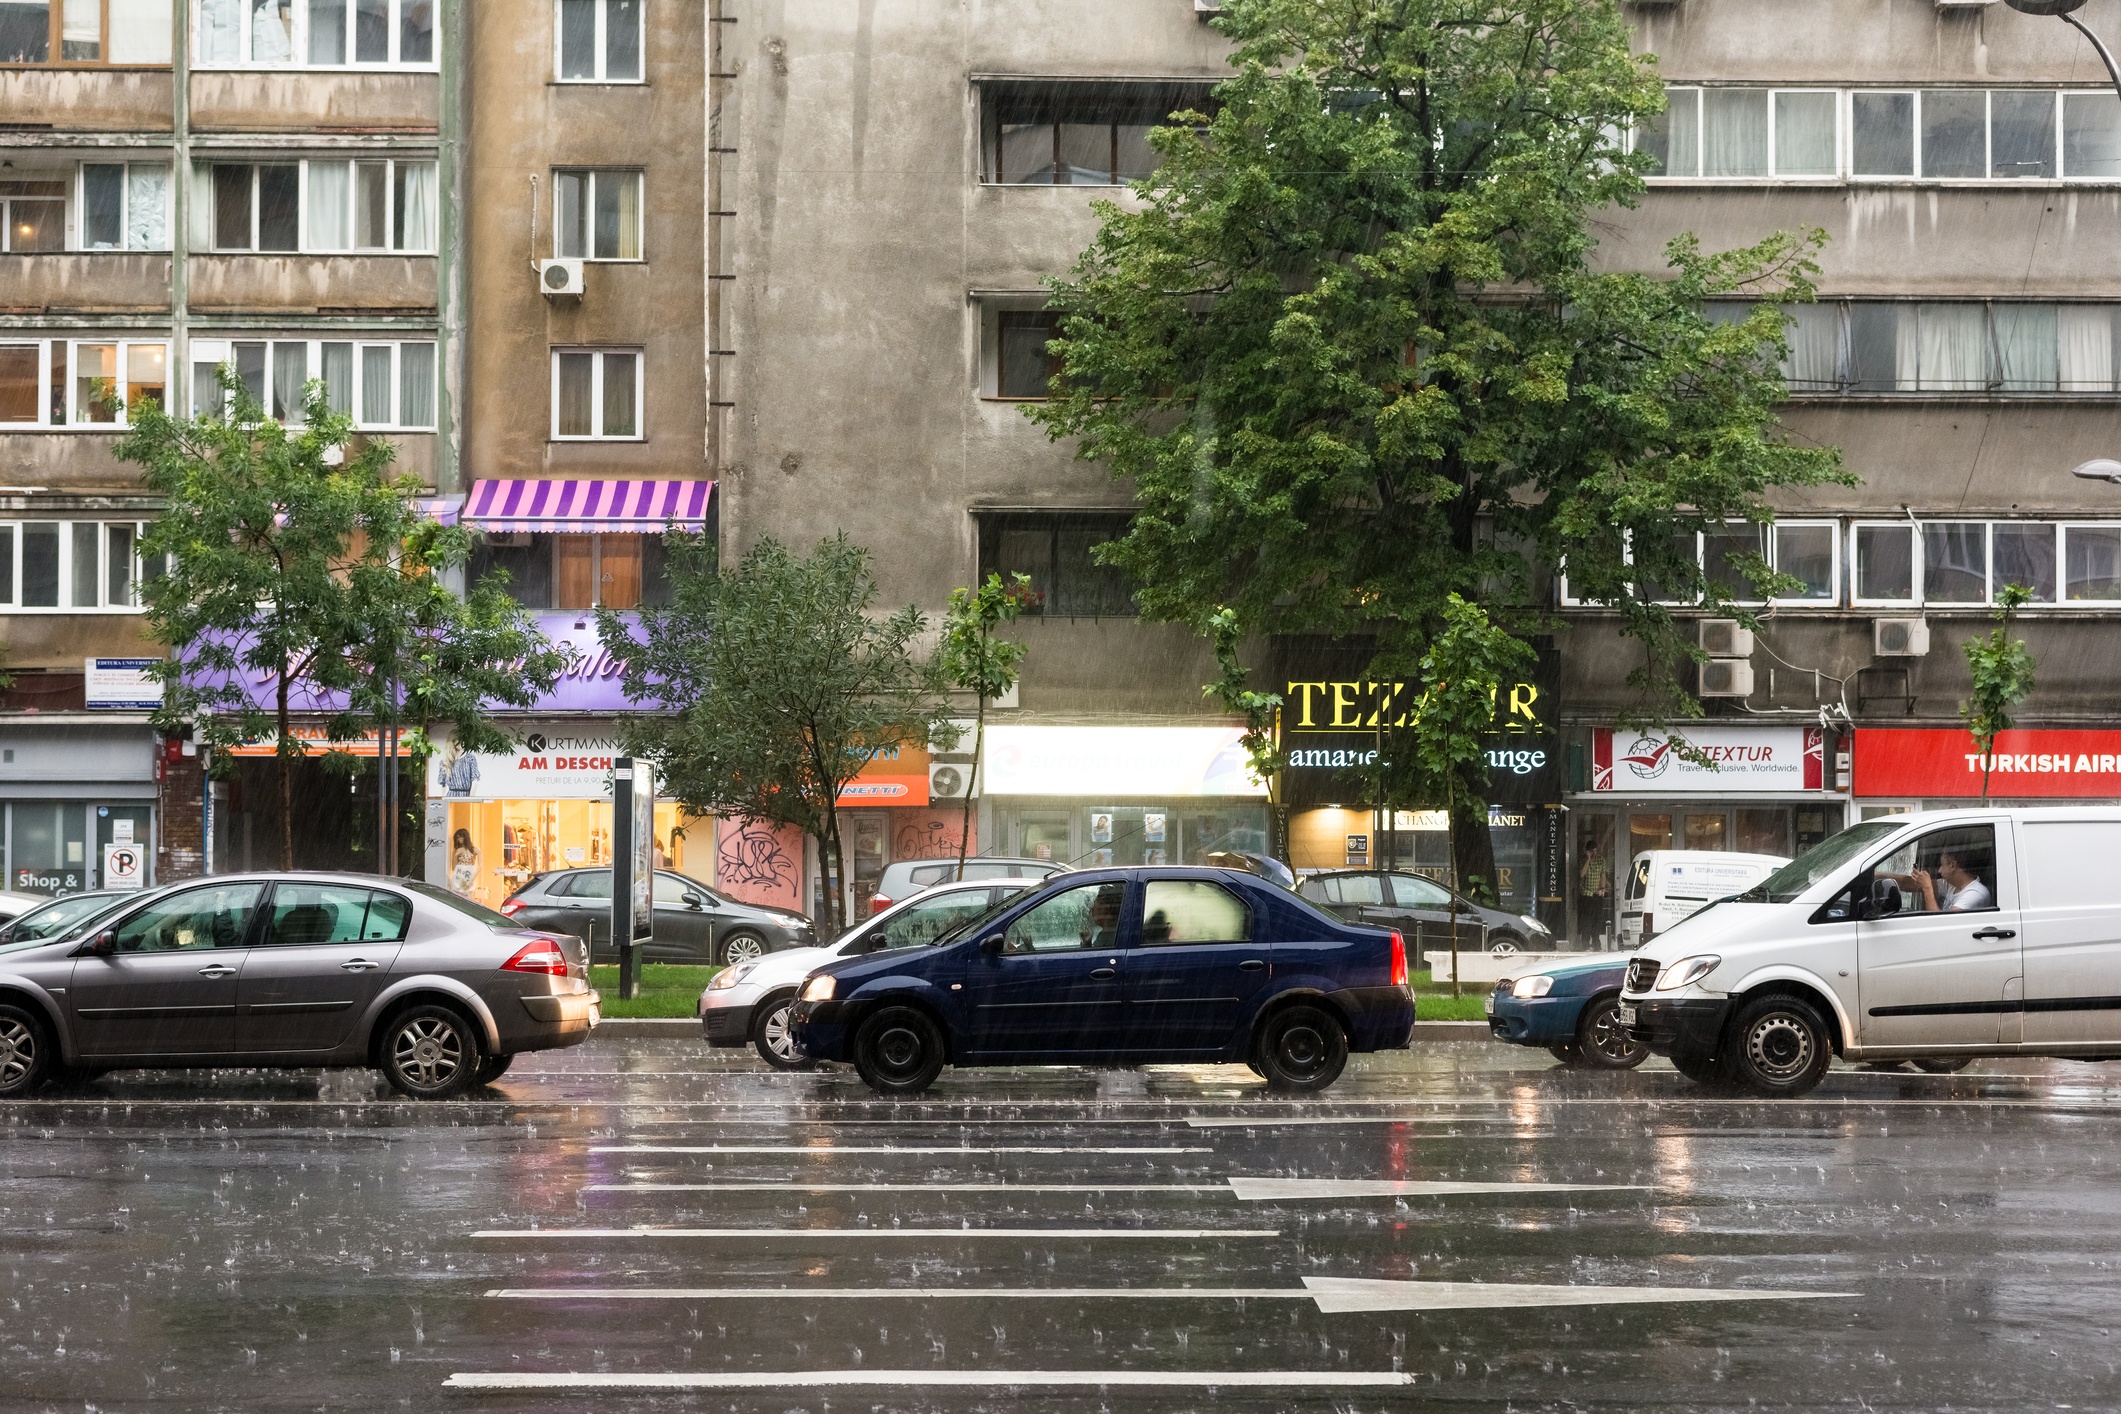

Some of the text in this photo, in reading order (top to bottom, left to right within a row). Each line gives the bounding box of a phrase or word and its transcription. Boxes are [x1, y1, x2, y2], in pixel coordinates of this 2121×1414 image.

[518, 757, 612, 769] AM DESCH
[1751, 764, 1800, 772] Worldwide.
[1965, 754, 2121, 772] TURKISH AIR
[1549, 808, 1557, 844] AMANET
[20, 874, 77, 890] Shop &
